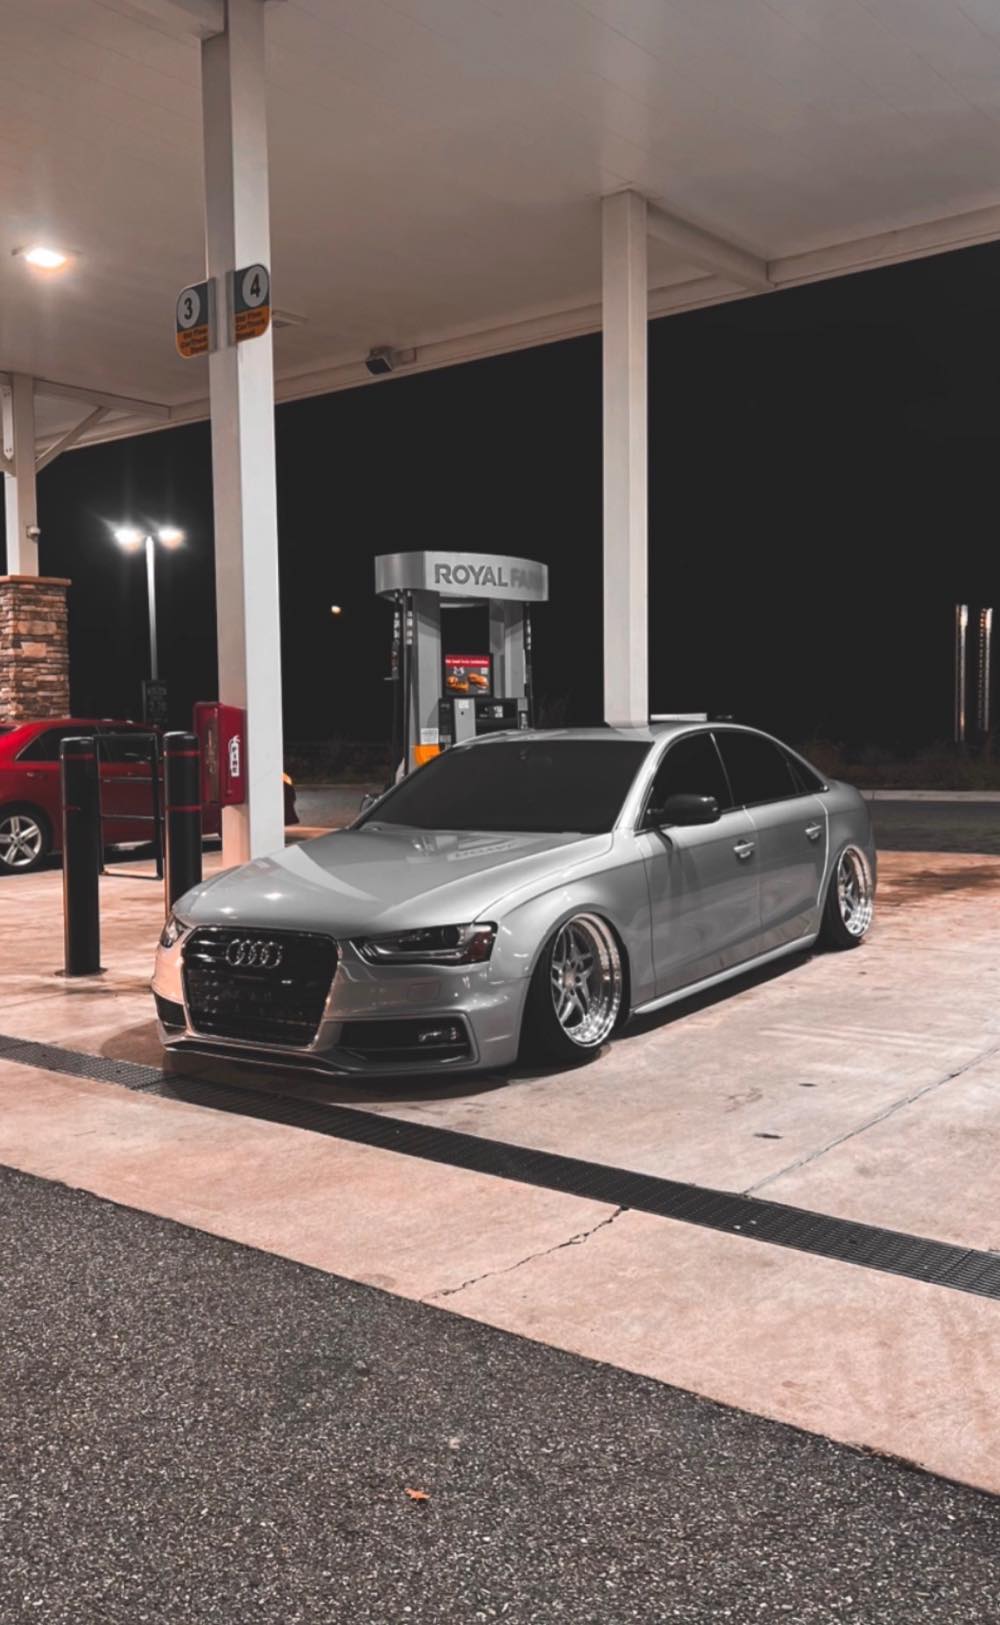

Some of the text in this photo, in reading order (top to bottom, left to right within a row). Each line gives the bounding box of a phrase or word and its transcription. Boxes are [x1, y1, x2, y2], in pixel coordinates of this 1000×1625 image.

[250, 273, 261, 298] 4
[184, 297, 193, 320] 3
[434, 563, 508, 587] ROYAL
